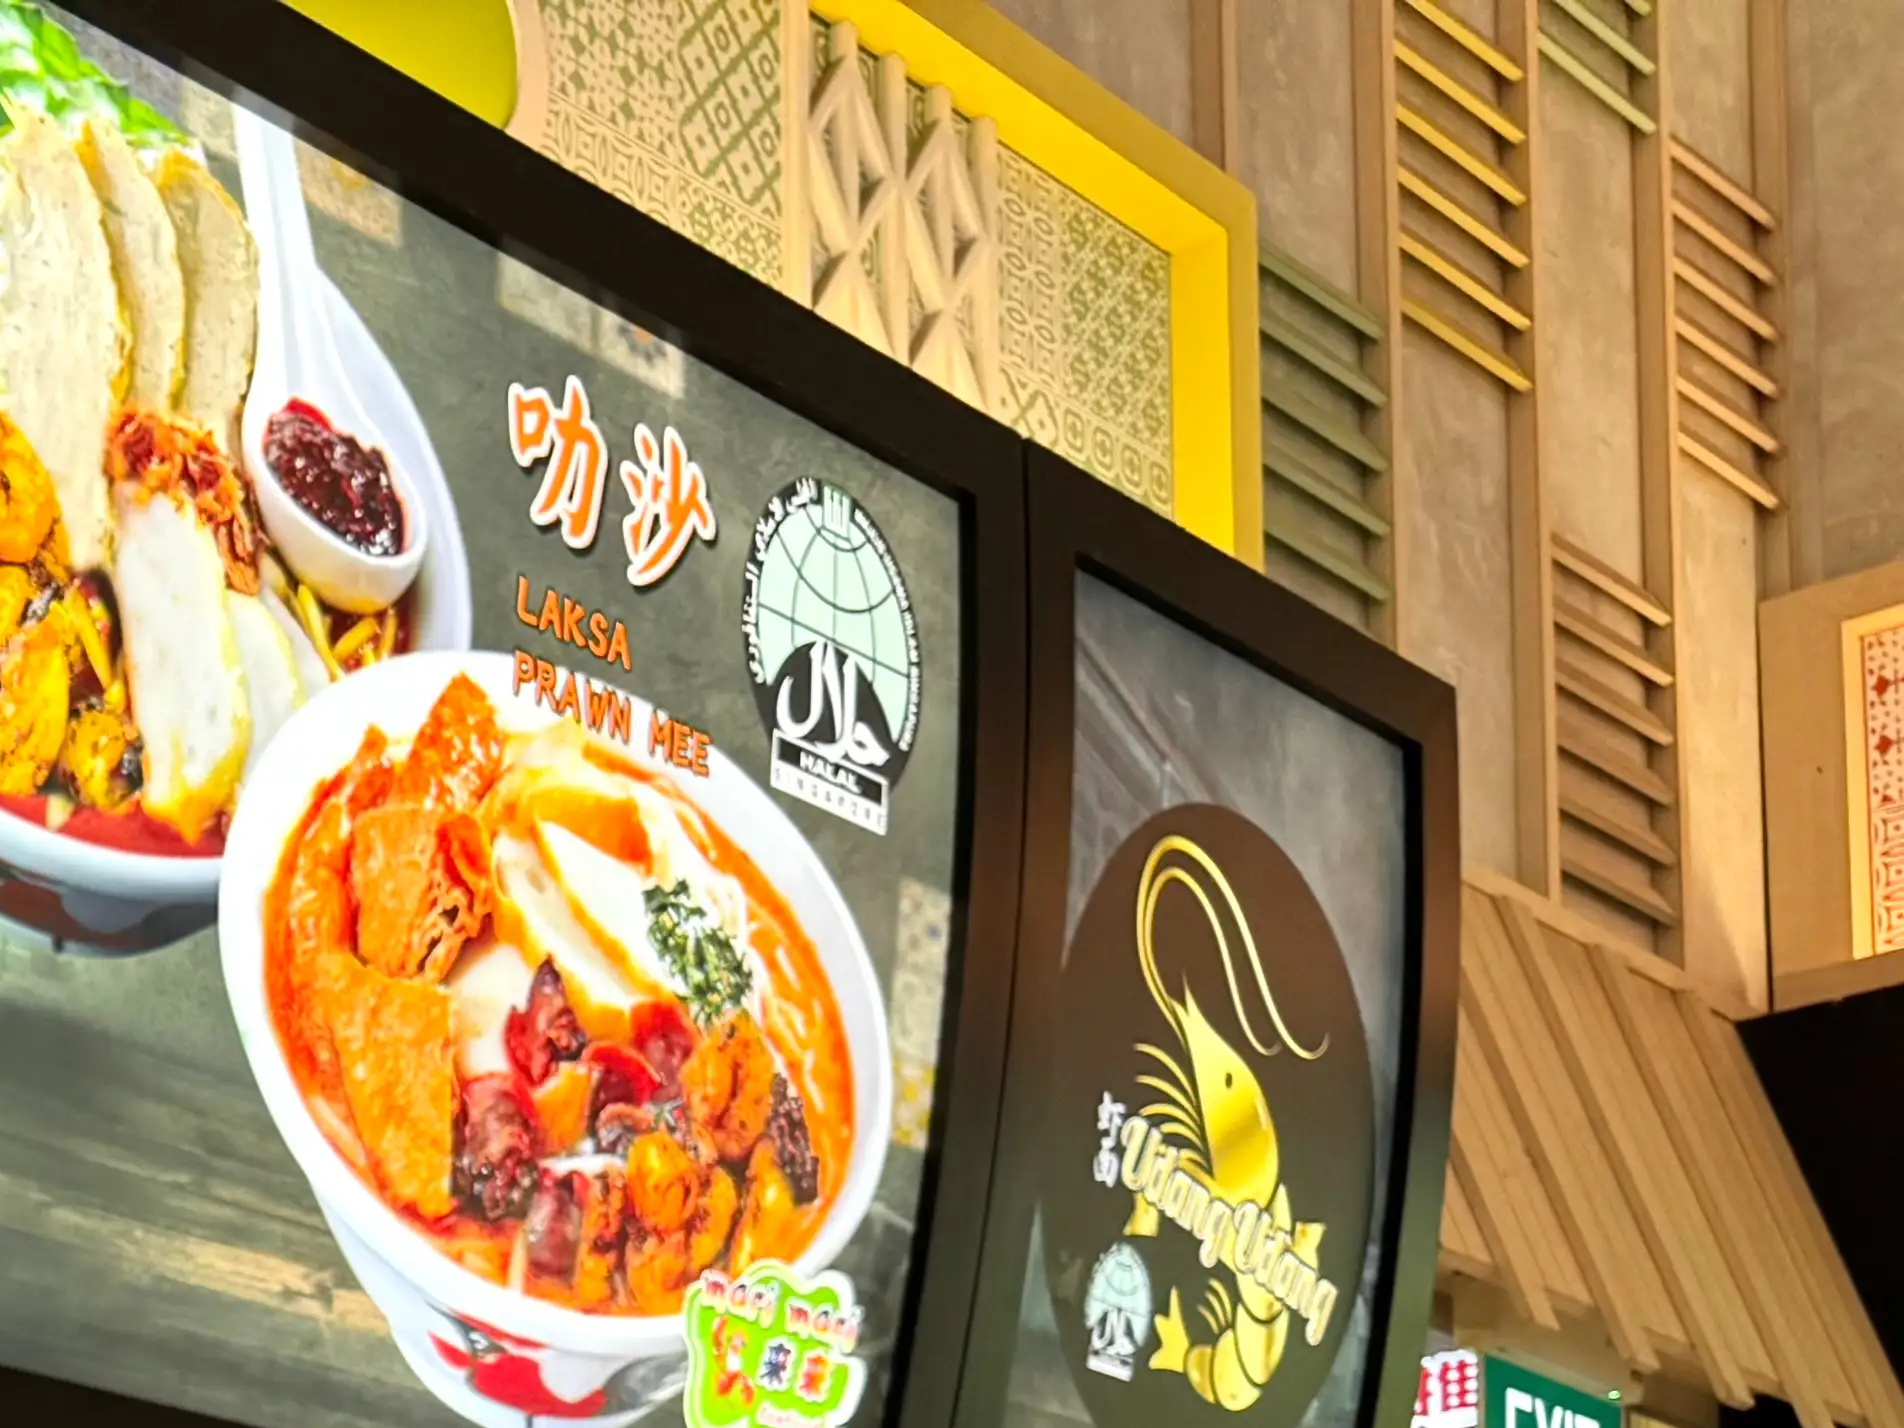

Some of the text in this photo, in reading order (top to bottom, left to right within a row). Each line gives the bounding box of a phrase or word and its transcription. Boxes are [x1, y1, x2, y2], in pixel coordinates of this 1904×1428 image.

[510, 380, 713, 580] 叻沙
[517, 575, 632, 670] LAKSA
[512, 650, 712, 777] PRAWN MEE
[799, 754, 860, 799] HALAL
[1121, 1116, 1338, 1346] Udang Udang
